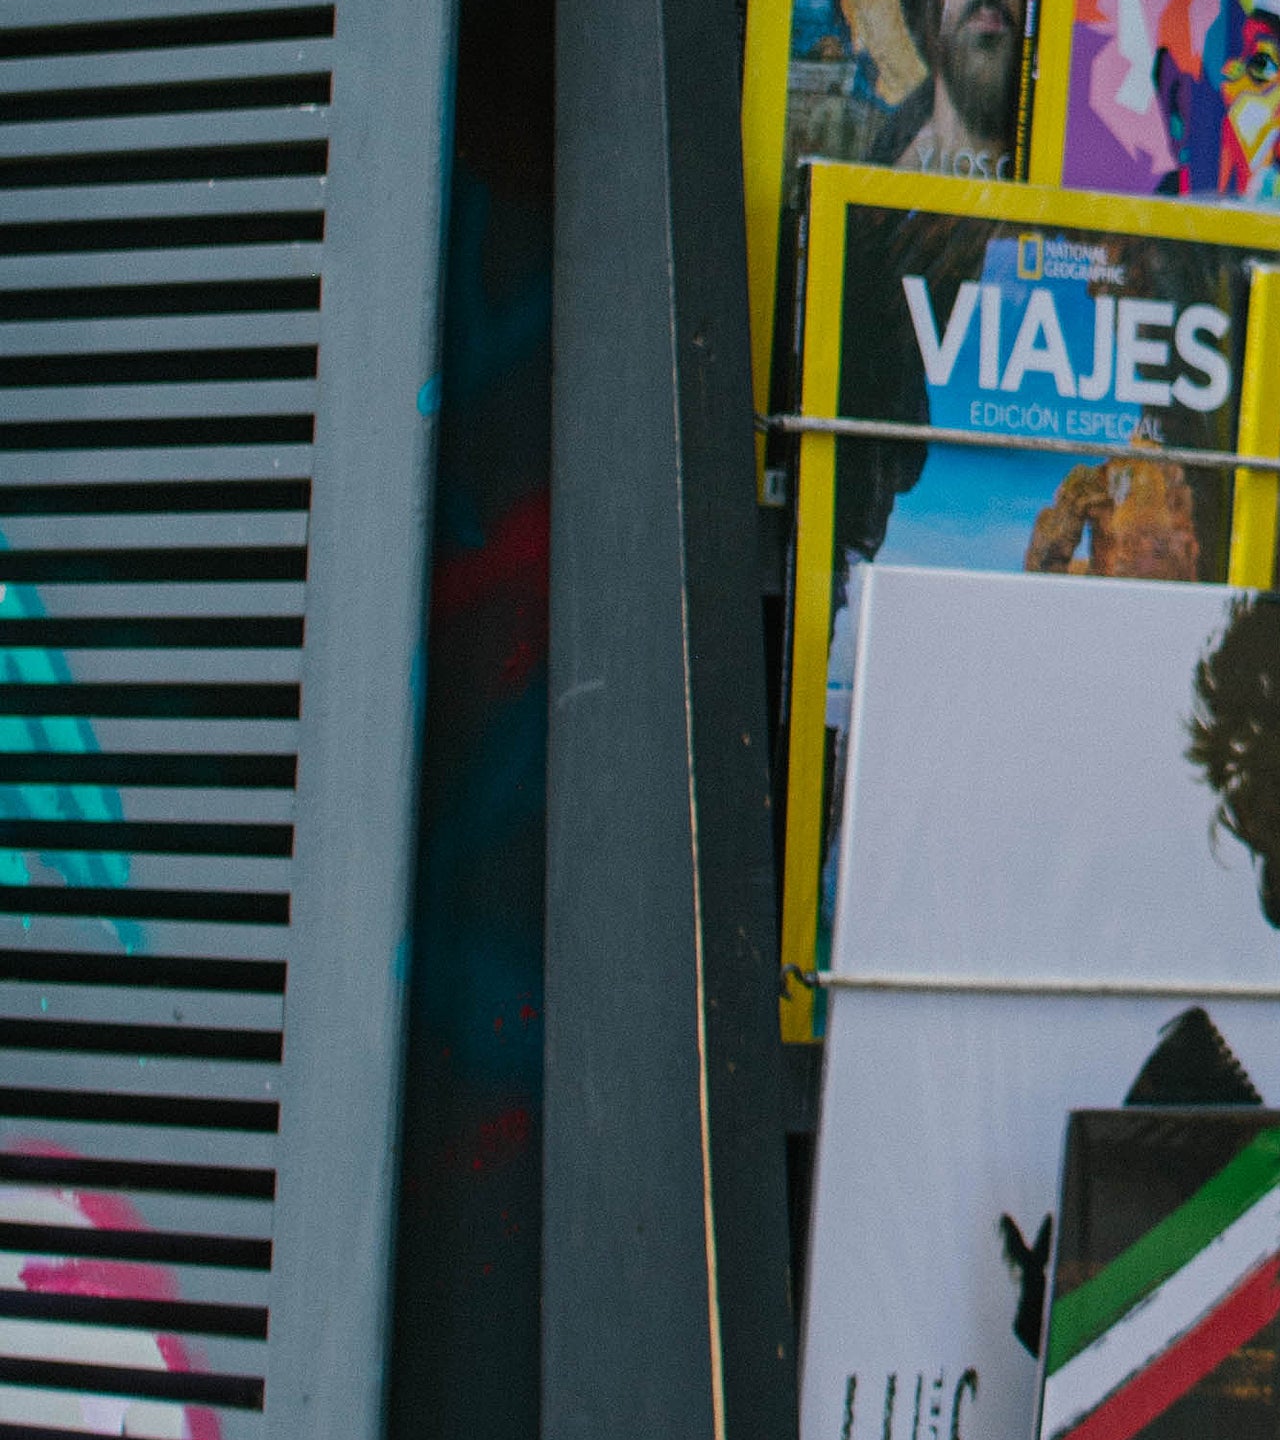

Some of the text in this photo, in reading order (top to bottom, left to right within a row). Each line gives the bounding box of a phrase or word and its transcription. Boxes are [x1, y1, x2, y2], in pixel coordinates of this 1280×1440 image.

[902, 275, 1233, 412] VIAJES
[970, 400, 1164, 443] EDICIÓN ESPECIAL
